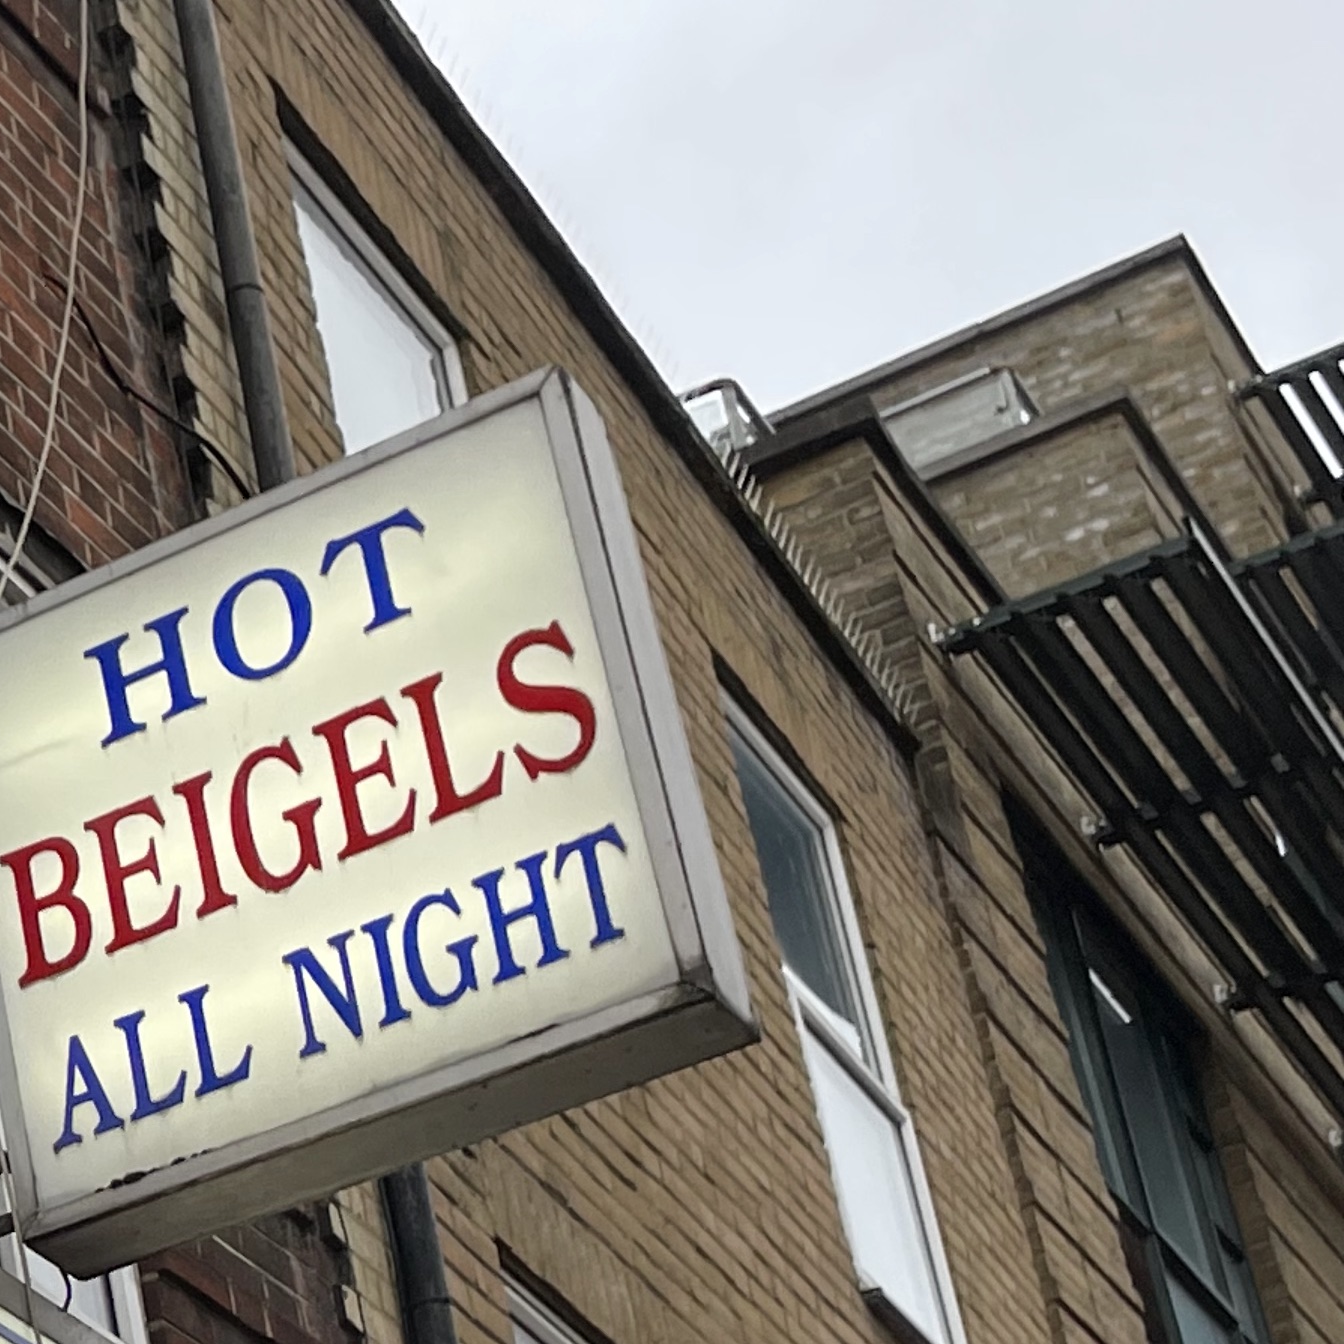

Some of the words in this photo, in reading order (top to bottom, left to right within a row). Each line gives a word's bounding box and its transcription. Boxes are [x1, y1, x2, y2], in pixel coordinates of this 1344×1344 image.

[84, 508, 425, 748] HOT
[53, 985, 252, 1154] ALL
[283, 824, 627, 1059] NIGHT
